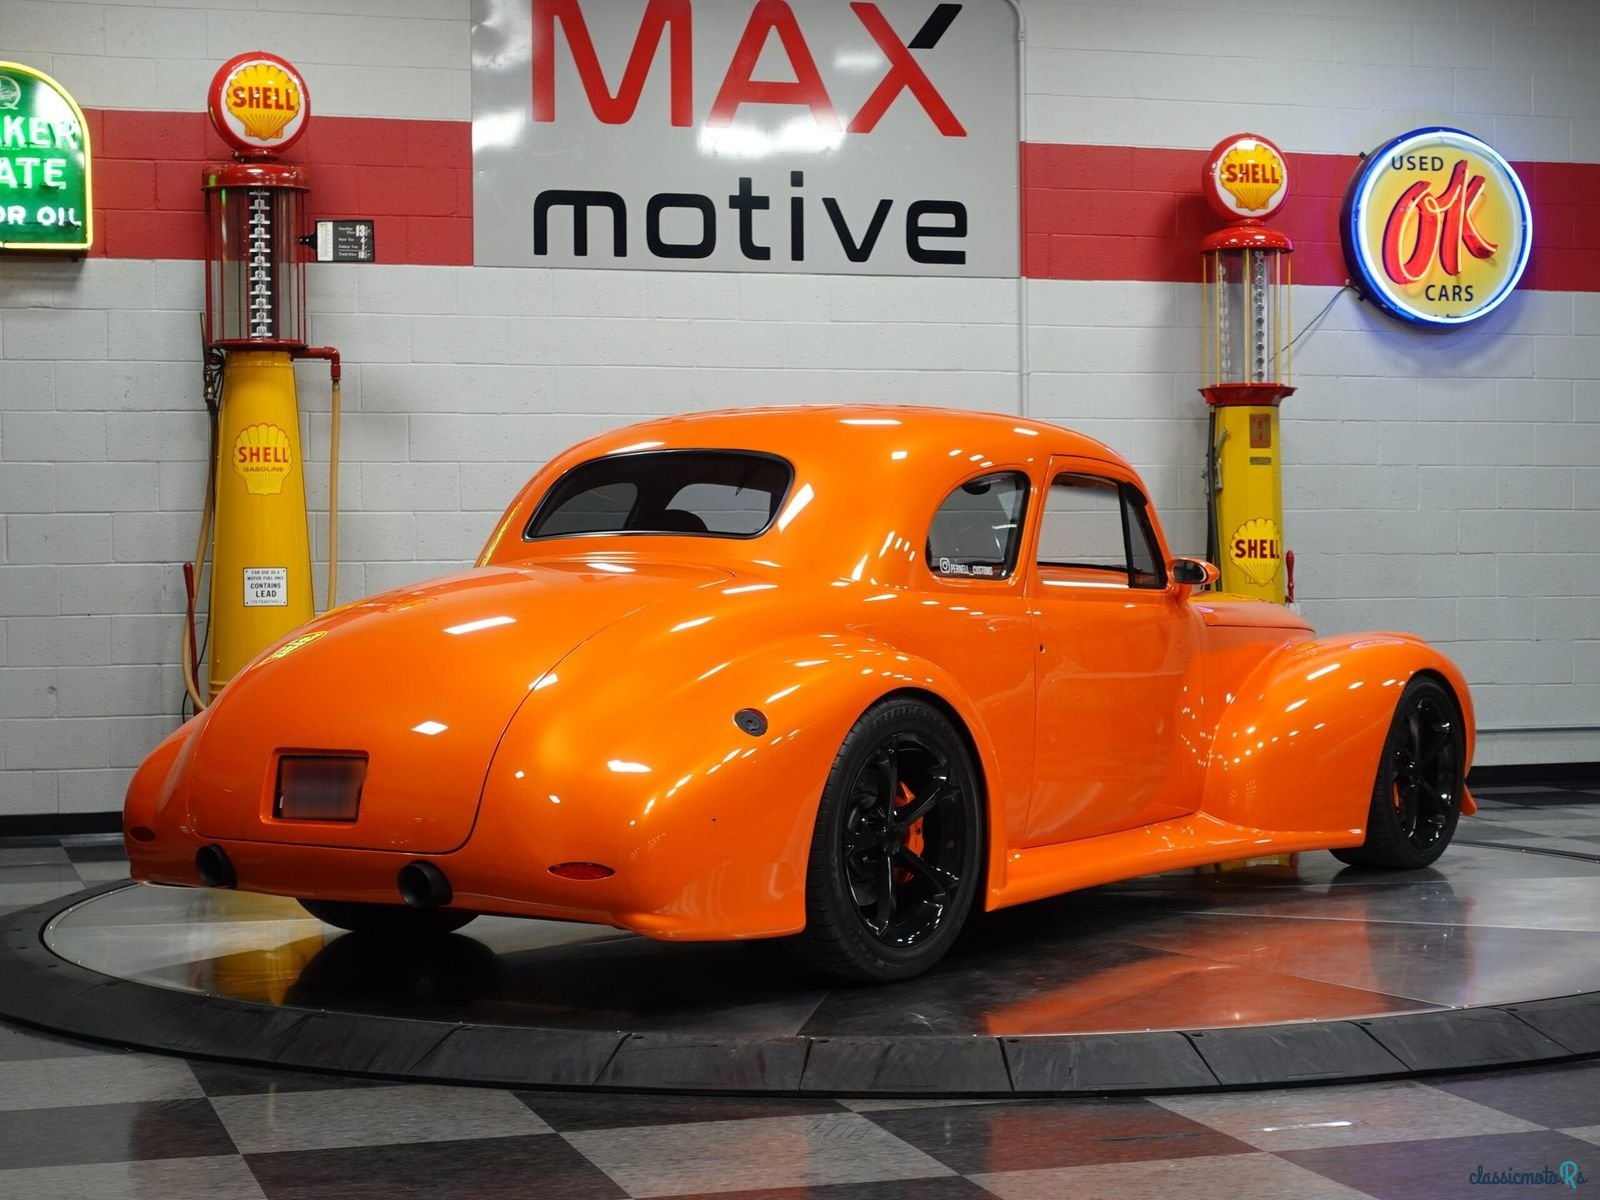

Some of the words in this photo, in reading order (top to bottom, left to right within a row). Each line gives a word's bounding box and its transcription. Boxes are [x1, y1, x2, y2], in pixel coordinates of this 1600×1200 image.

[531, 0, 967, 137] MAX
[232, 86, 296, 111] SHELL
[0, 115, 79, 149] KER
[1225, 163, 1279, 184] SHELL
[1391, 155, 1444, 171] USED
[37, 206, 82, 227] OIL
[534, 170, 967, 265] motive
[1382, 159, 1498, 285] OK
[1425, 284, 1474, 302] CARS
[238, 446, 288, 463] SHELL
[1235, 539, 1280, 559] SHELL
[255, 590, 277, 598] LEAD
